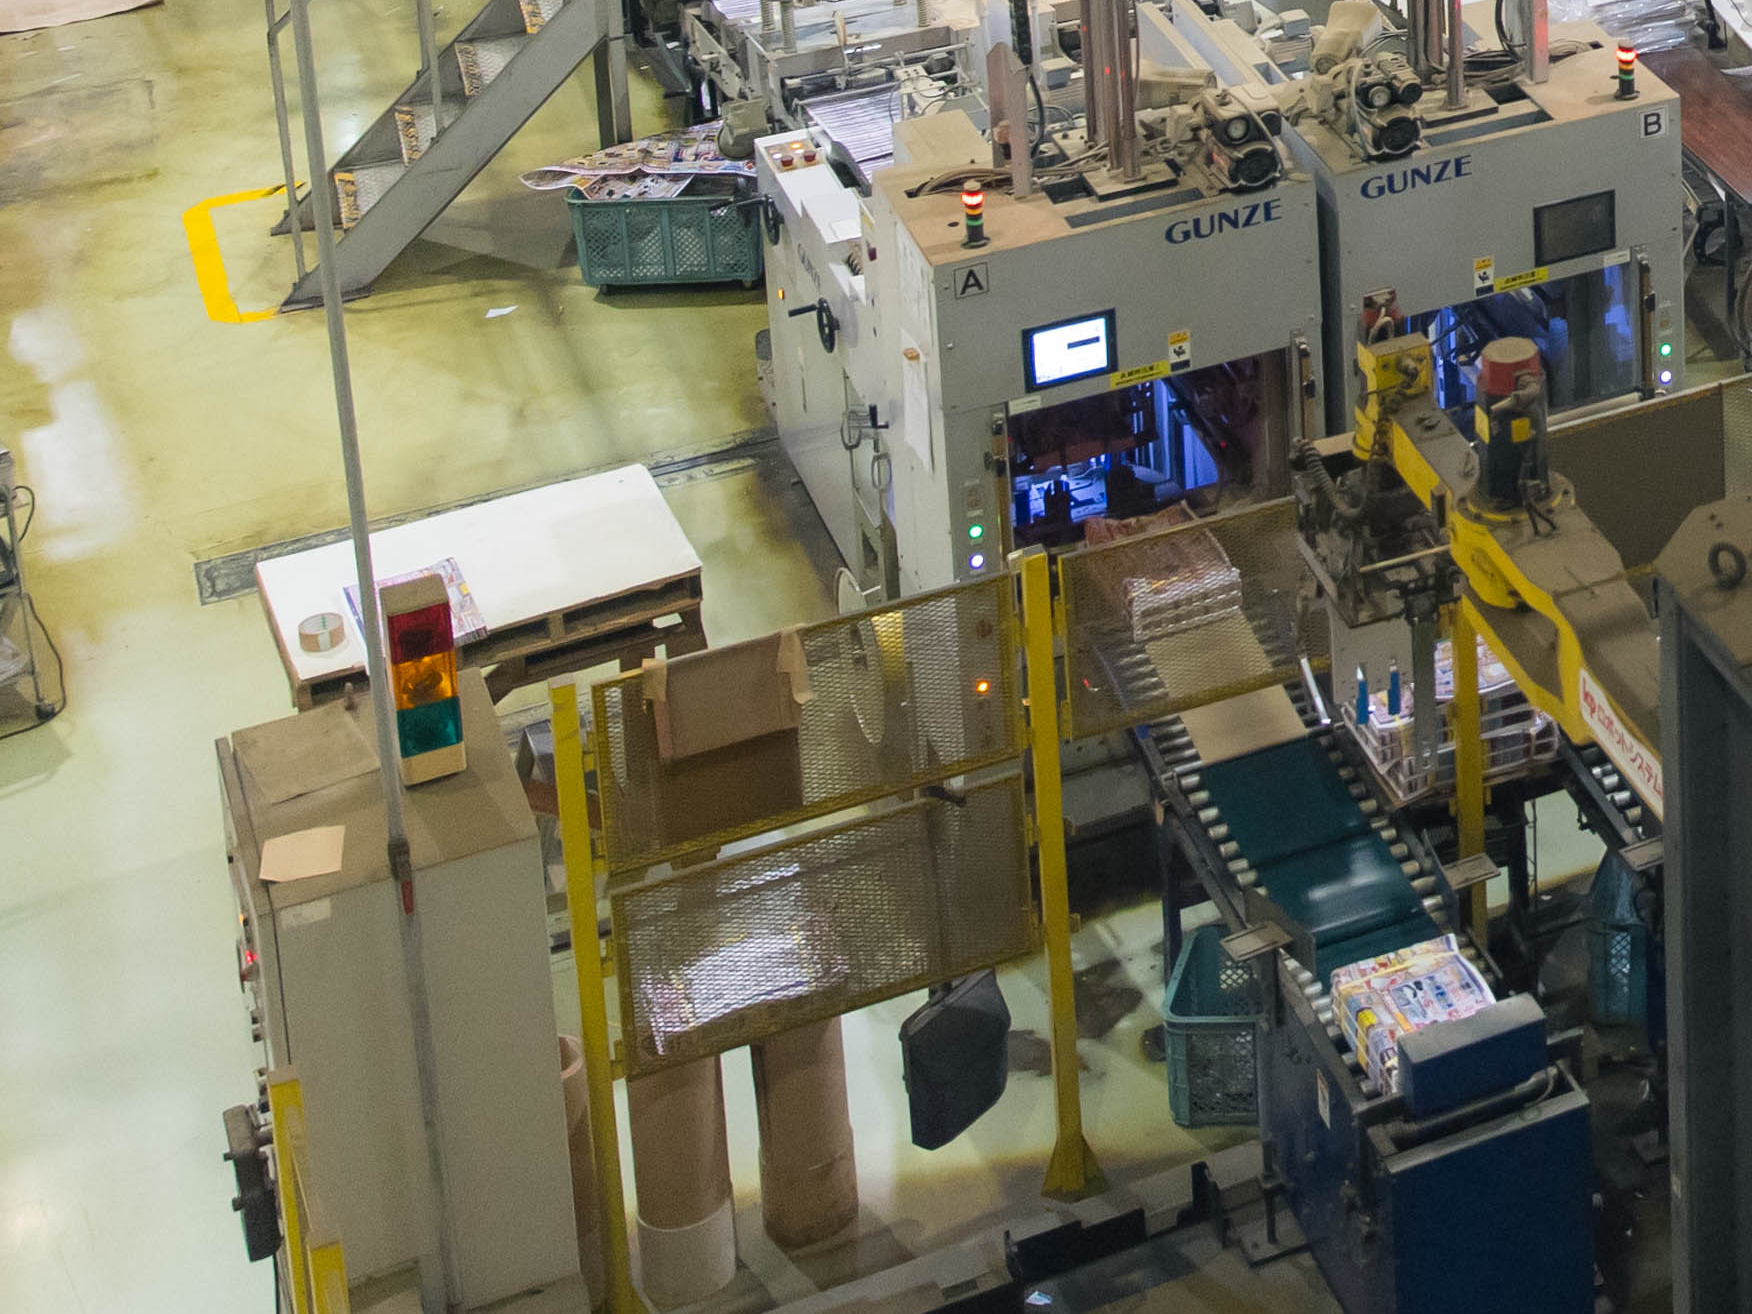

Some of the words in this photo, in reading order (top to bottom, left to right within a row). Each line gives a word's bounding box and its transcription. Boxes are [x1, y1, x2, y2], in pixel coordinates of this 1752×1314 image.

[1643, 112, 1662, 137] B
[1360, 155, 1473, 199] GUNZE
[1165, 198, 1282, 244] GUNZE
[960, 269, 984, 295] A
